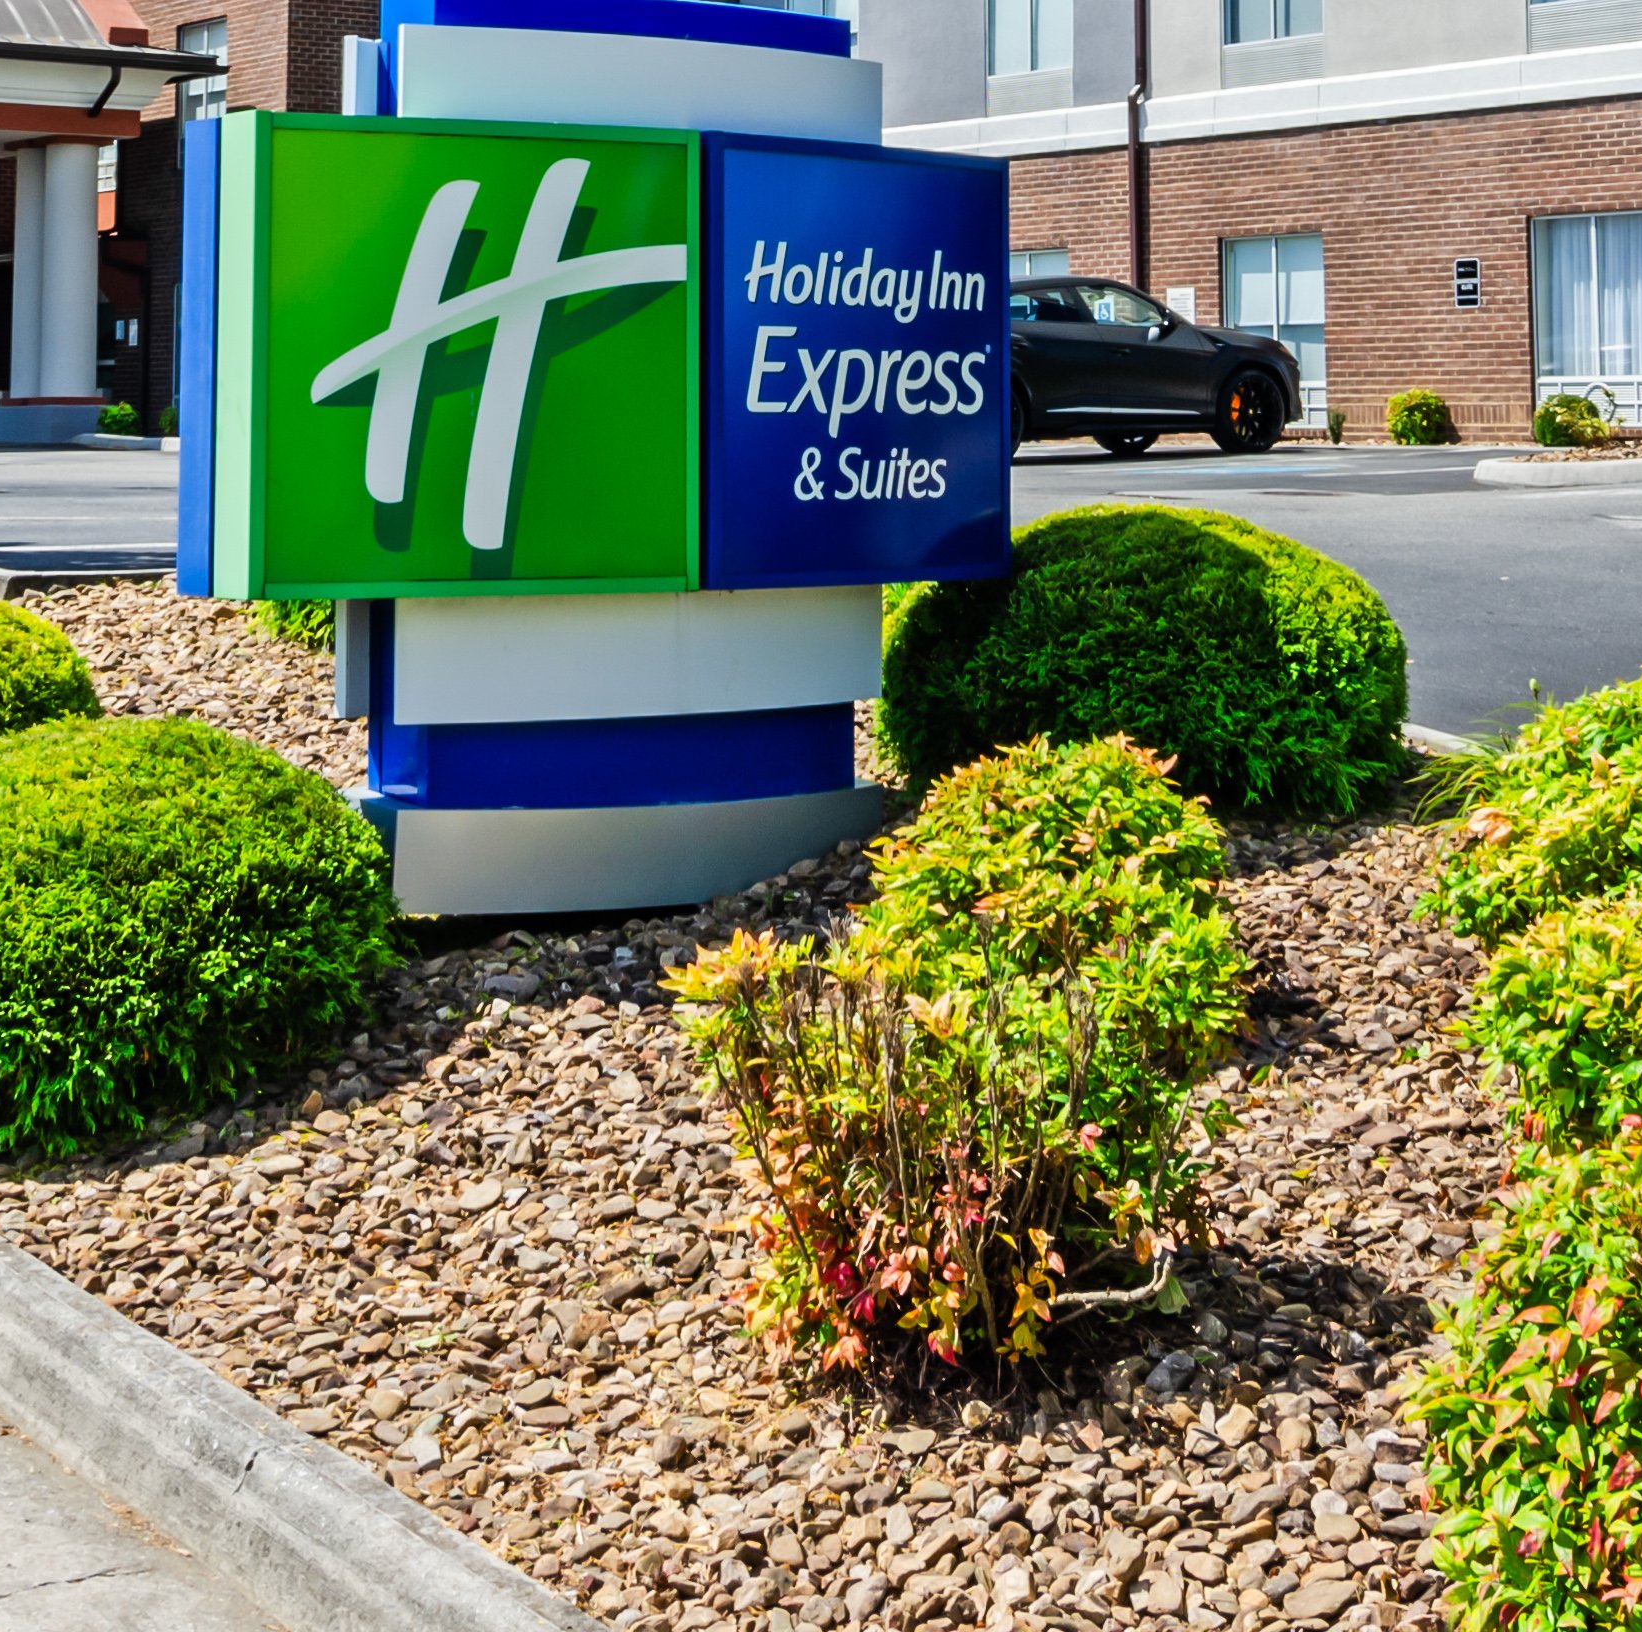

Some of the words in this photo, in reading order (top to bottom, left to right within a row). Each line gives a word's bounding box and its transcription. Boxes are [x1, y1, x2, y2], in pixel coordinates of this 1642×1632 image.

[744, 240, 923, 324] Holiday
[928, 249, 986, 312] Inn
[746, 325, 986, 439] Express
[793, 446, 825, 501] &
[834, 446, 947, 501] Suites
